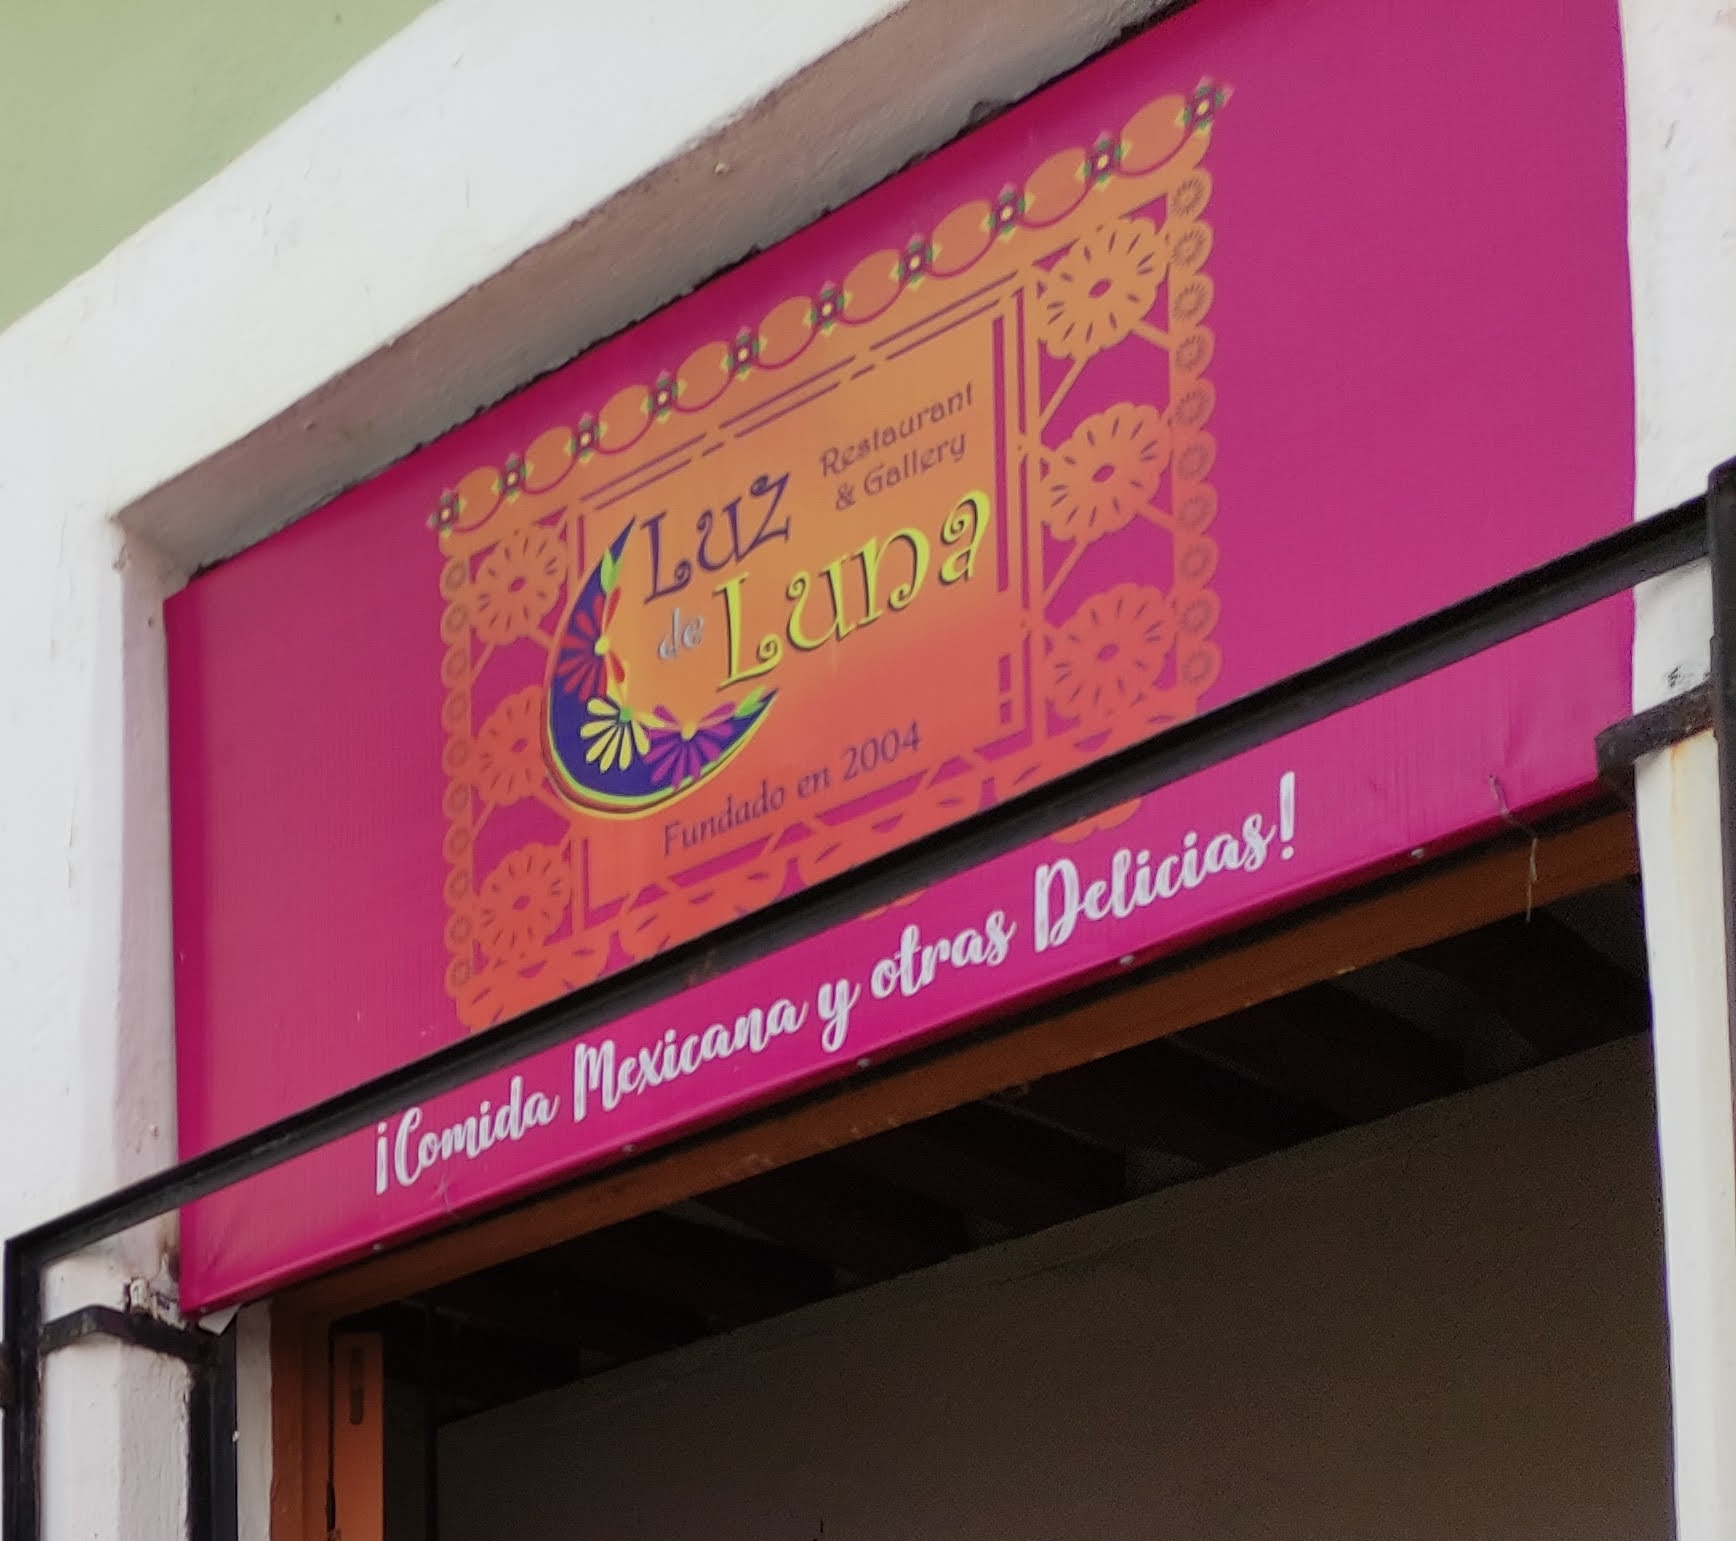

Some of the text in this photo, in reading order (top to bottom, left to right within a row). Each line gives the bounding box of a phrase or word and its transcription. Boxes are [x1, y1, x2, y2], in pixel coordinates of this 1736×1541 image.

[819, 381, 975, 478] Restaurant
[834, 432, 966, 511] & Gallery
[657, 490, 991, 693] de Luna
[663, 720, 921, 856] Fundado en 2004
[375, 770, 1296, 1196] ¡Comida Mexicana y otras Delicias!
